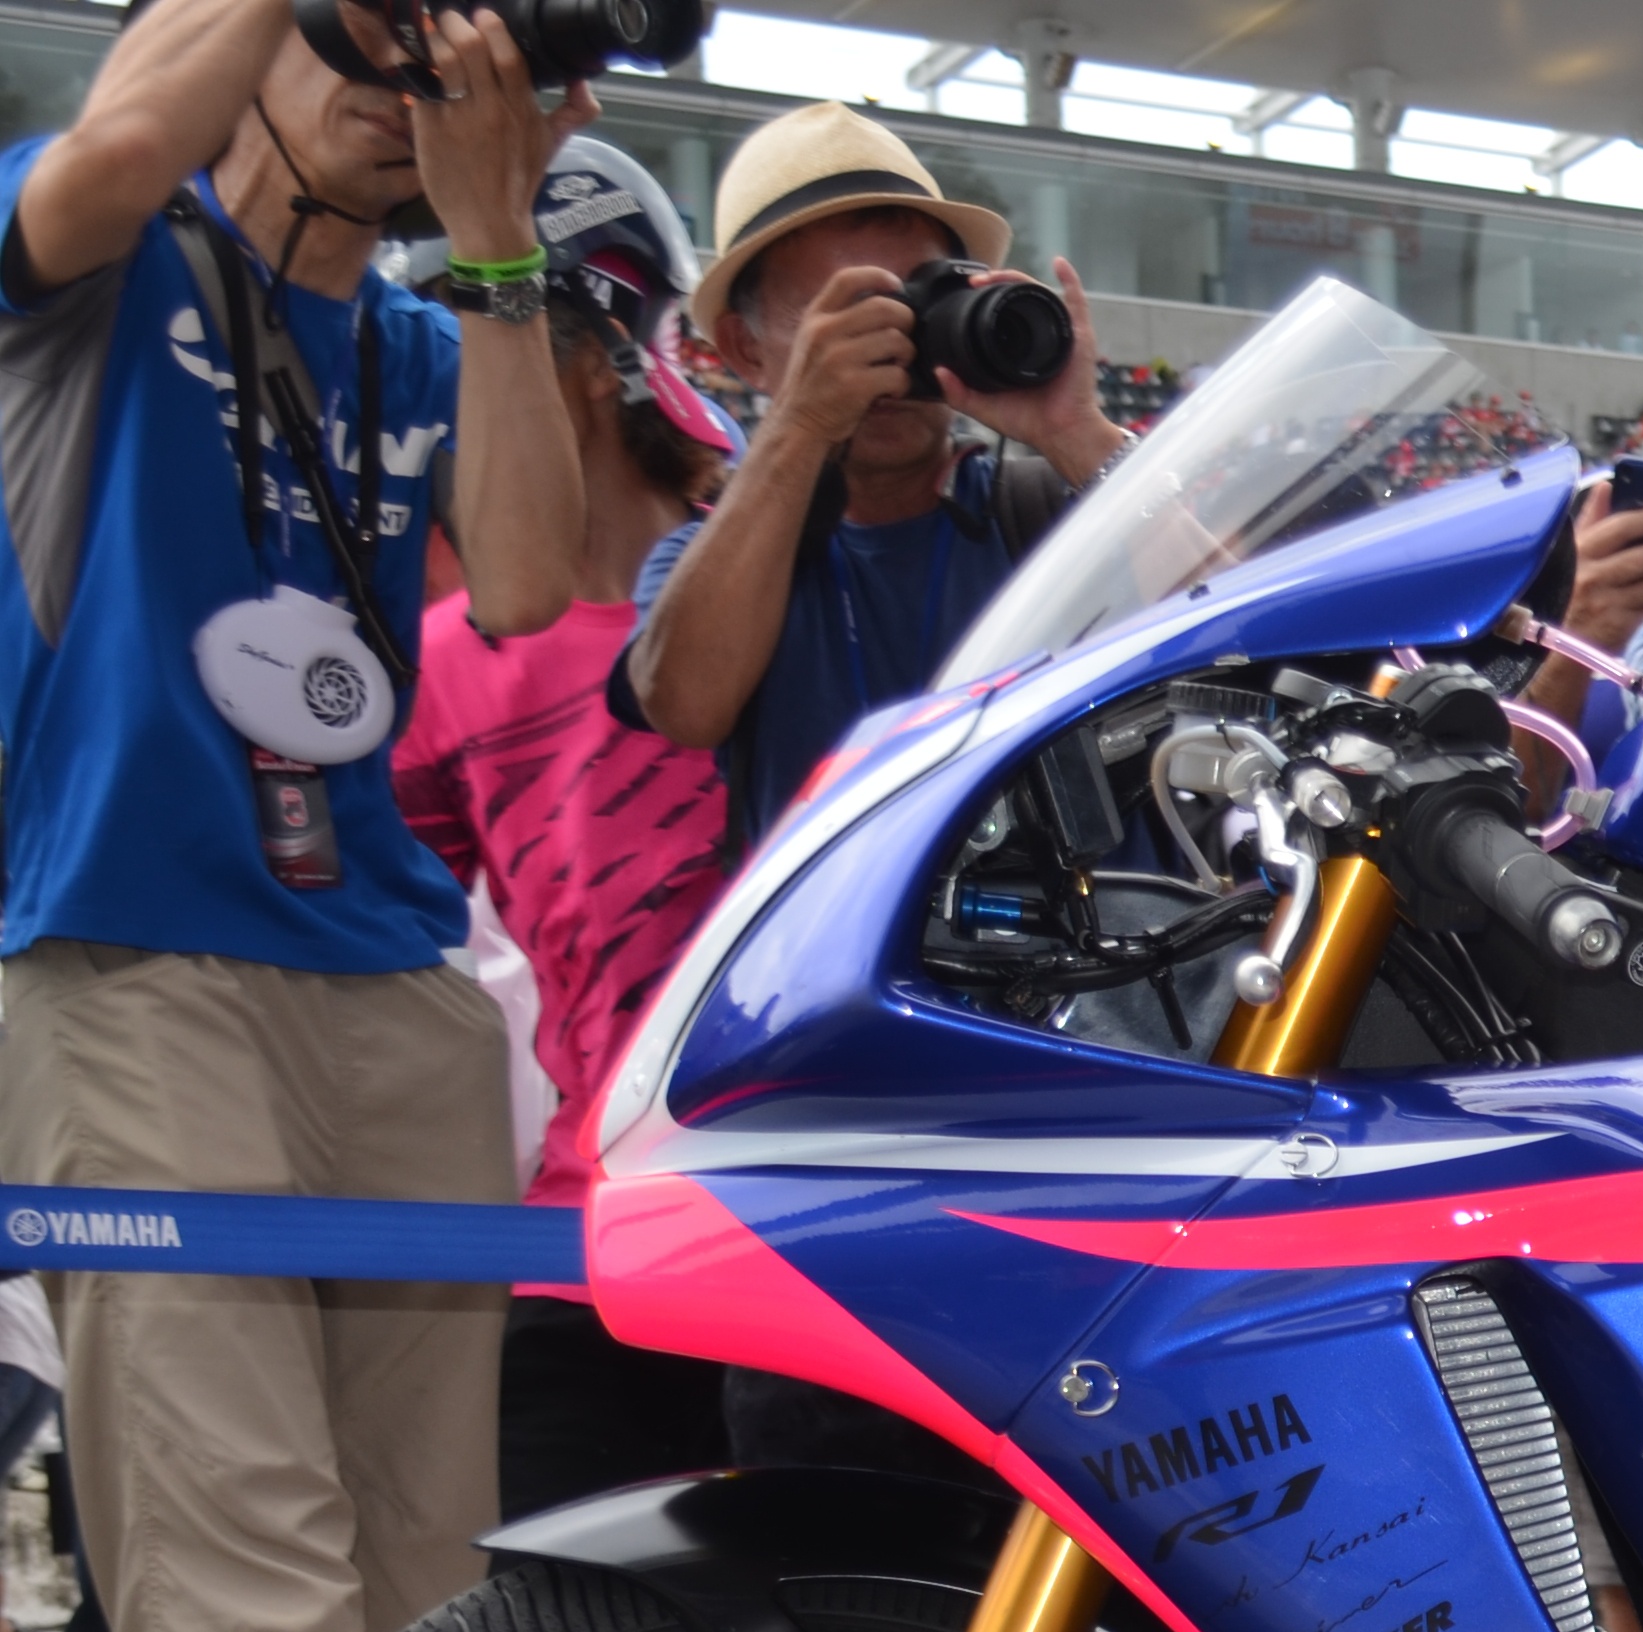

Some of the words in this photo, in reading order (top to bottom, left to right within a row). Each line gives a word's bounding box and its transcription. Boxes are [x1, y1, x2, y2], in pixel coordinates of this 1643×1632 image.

[46, 1211, 183, 1248] YAMAHA
[1081, 1393, 1313, 1504] YAMAHA
[1274, 1496, 1427, 1591] Kansai
